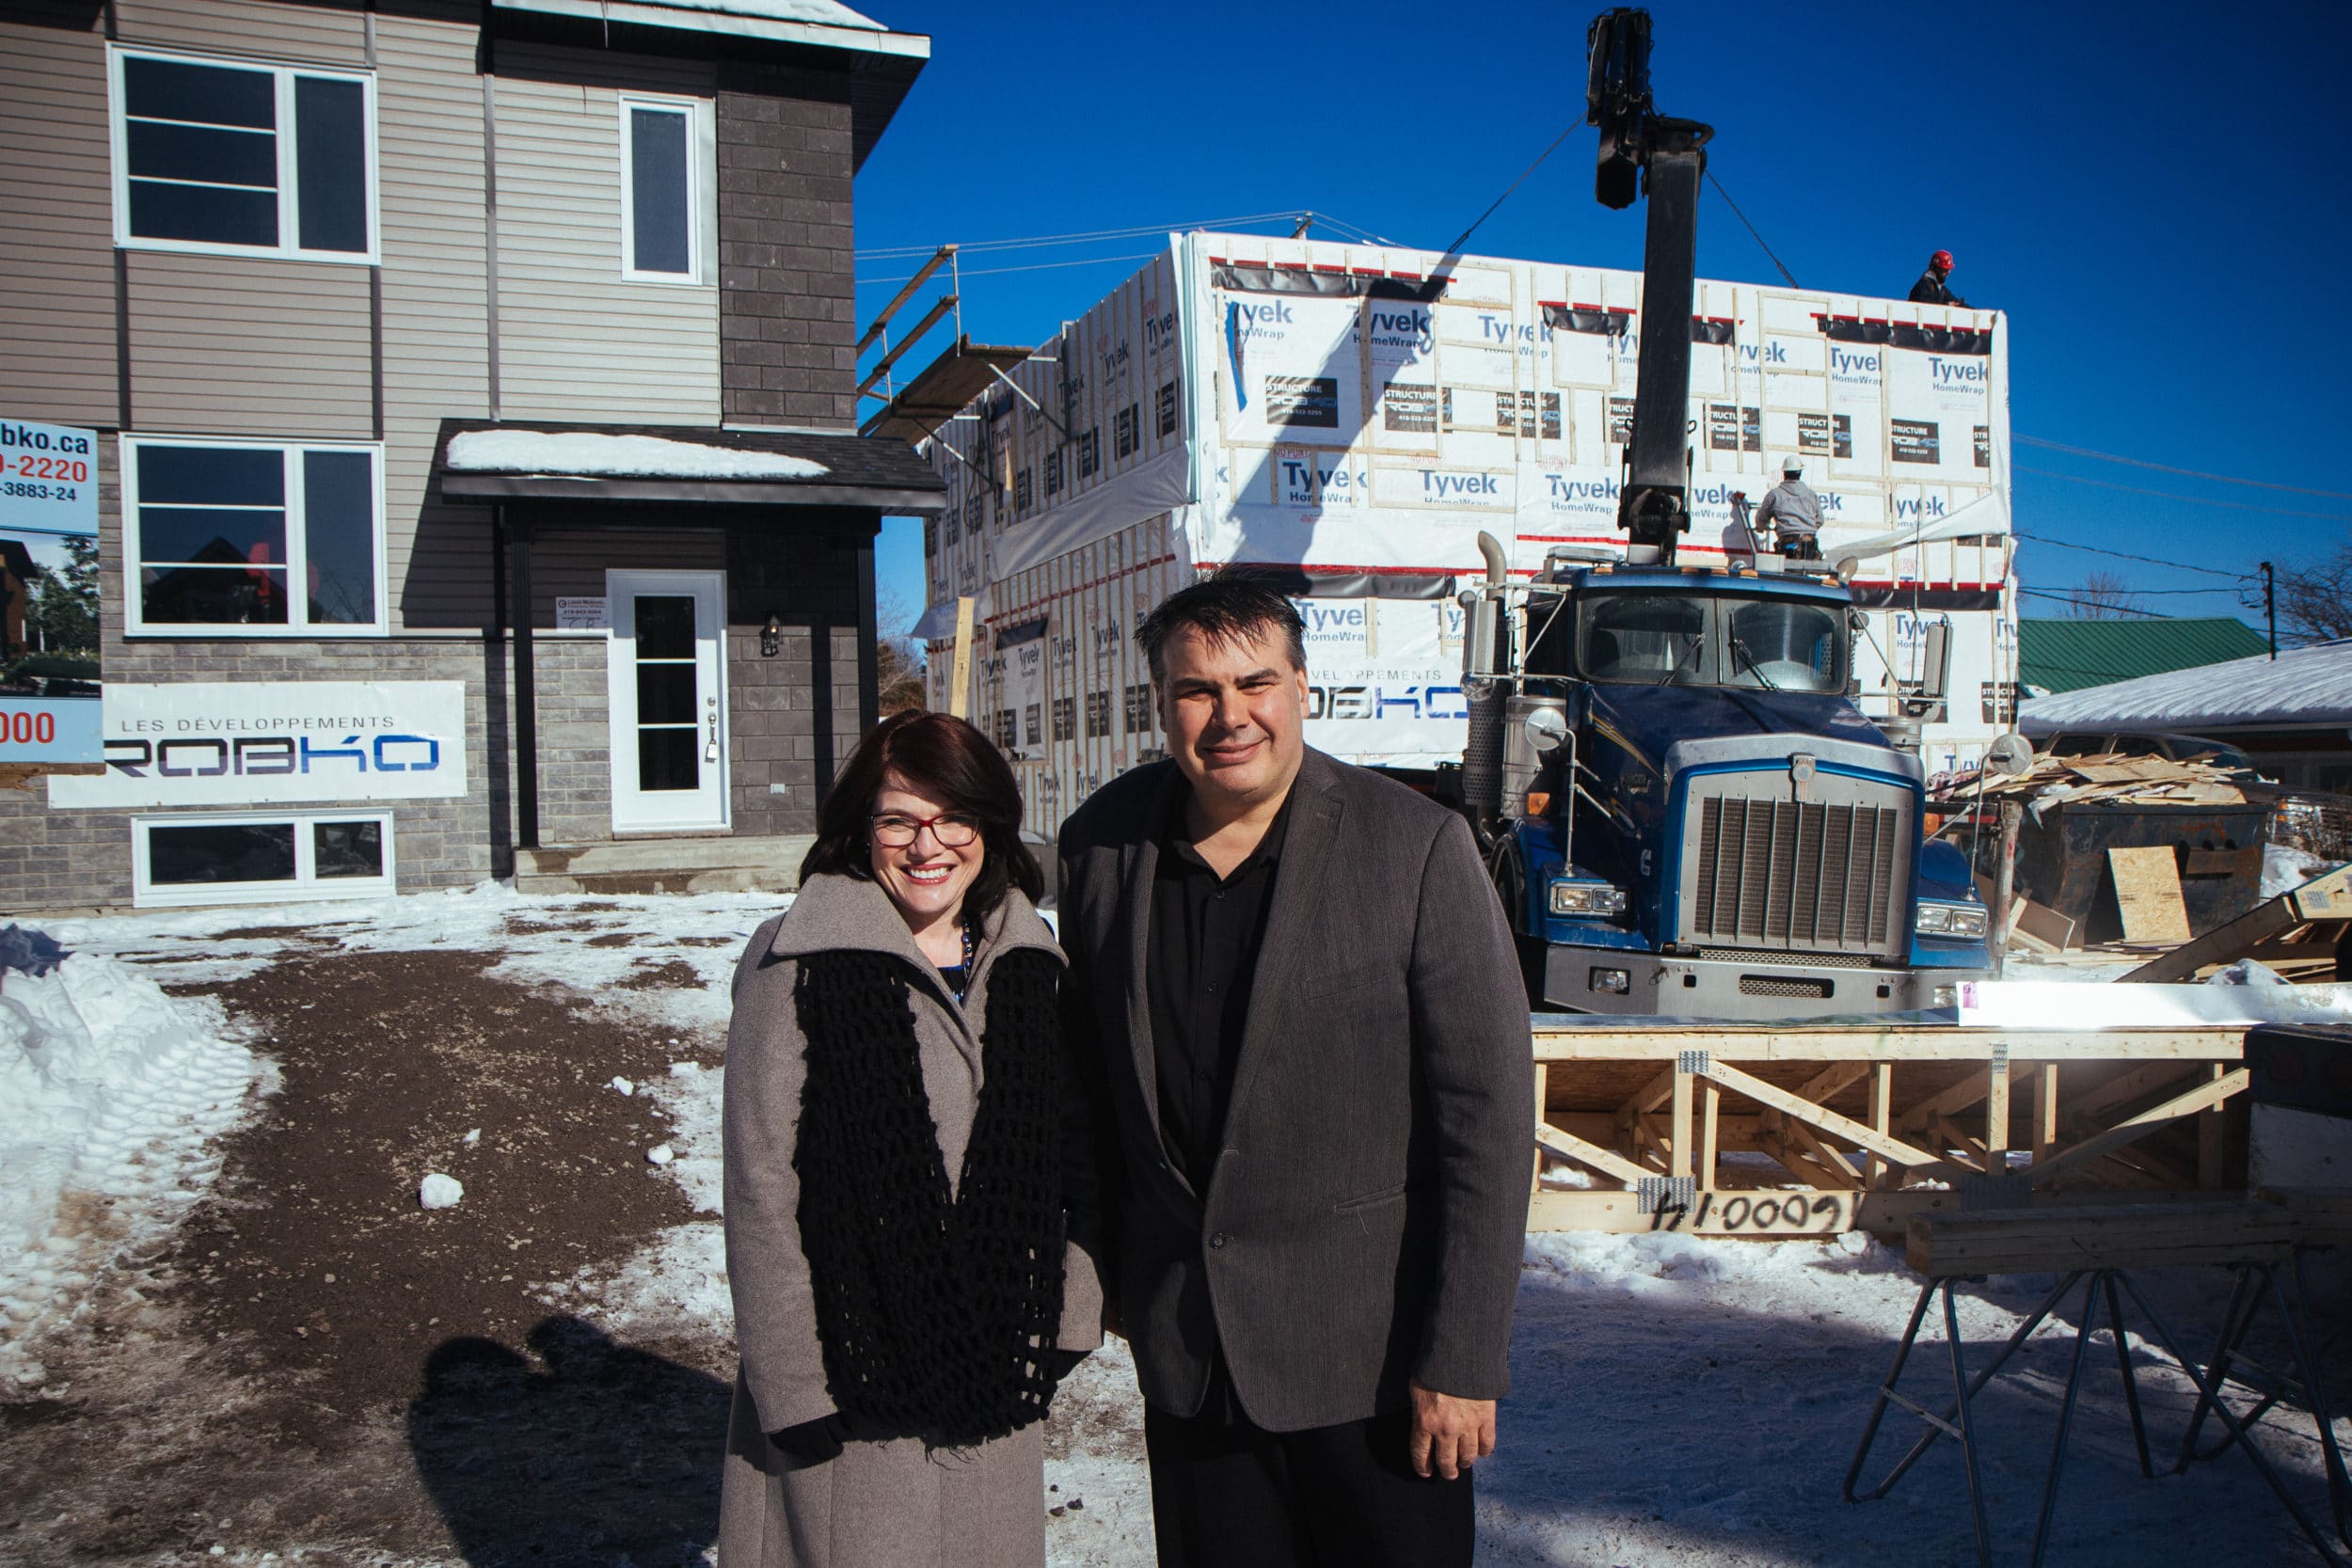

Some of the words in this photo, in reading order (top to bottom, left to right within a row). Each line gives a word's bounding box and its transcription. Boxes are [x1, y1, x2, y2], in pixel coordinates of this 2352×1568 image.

[1265, 384, 1324, 395] STRUCTURE
[1932, 383, 1985, 396] HomeWrap
[1418, 469, 1498, 498] Tyvek
[1545, 473, 1620, 501] Tyvek
[1551, 500, 1613, 515] HomeWrap
[1890, 494, 1946, 518] yvek
[1302, 631, 1365, 642] HomeWra
[121, 719, 166, 734] LES
[177, 714, 395, 733] DÉVELOPPEMENTS
[103, 734, 440, 778] ROBKO
